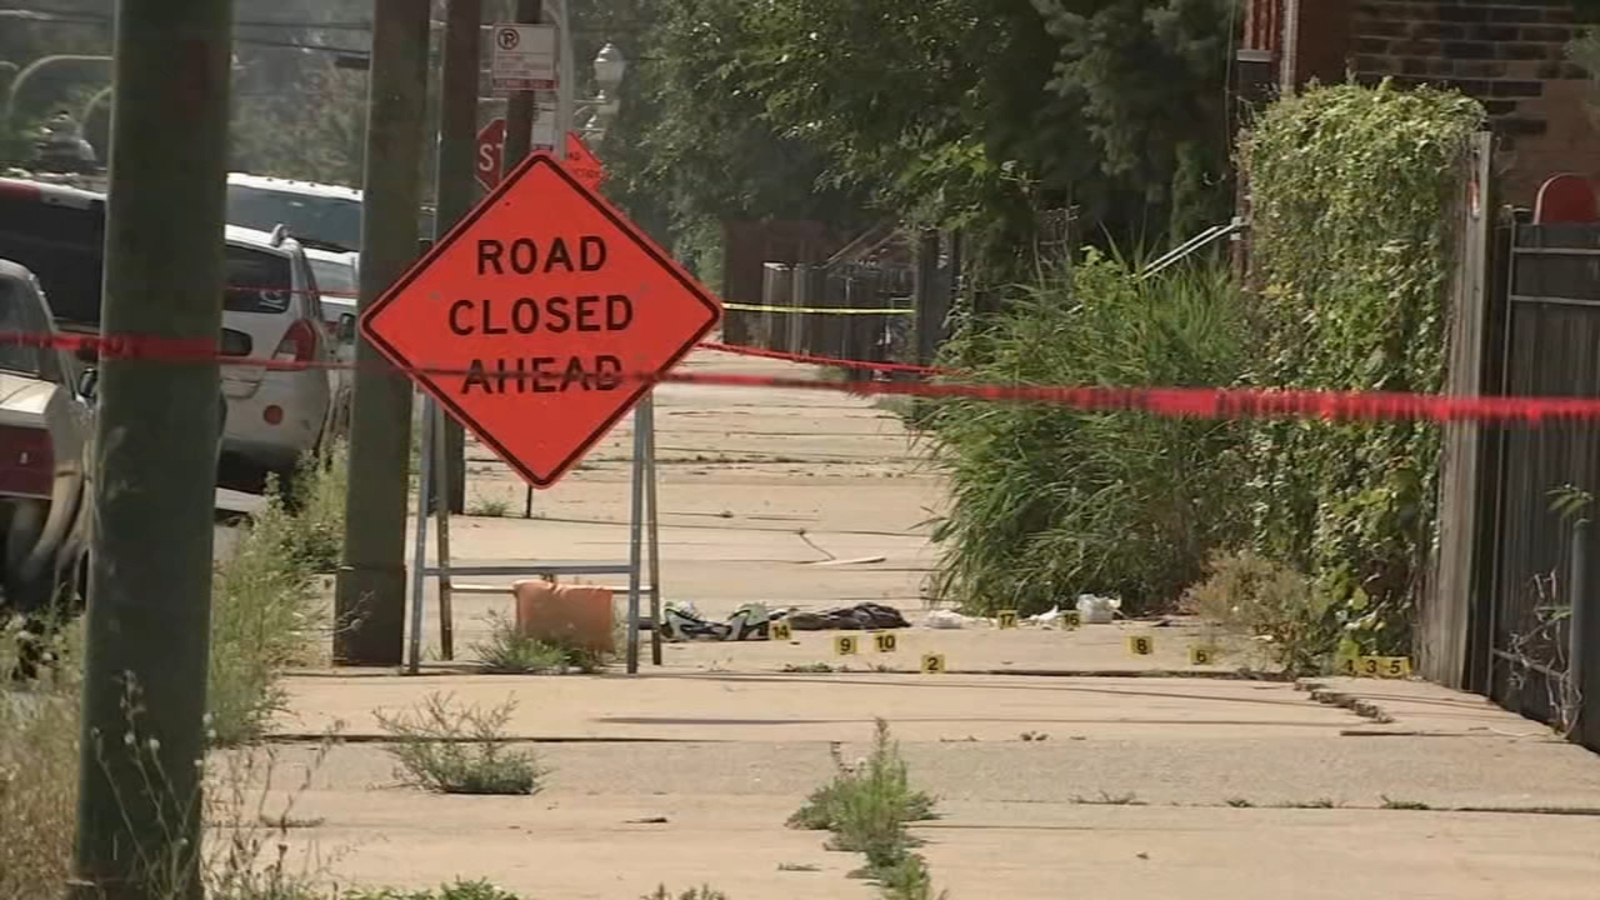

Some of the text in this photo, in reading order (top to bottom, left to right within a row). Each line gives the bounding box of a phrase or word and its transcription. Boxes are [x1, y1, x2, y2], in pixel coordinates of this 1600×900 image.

[478, 142, 506, 172] ST
[476, 235, 607, 276] ROAD
[448, 294, 633, 336] CLOSED
[461, 354, 623, 394] AHEAD
[1000, 613, 1015, 626] 17
[772, 624, 789, 638] 14
[840, 638, 851, 652] 9
[876, 635, 895, 649] 10
[1137, 638, 1147, 652] 8
[927, 656, 939, 670] 2
[1365, 659, 1377, 673] 3
[1389, 660, 1401, 674] 5
